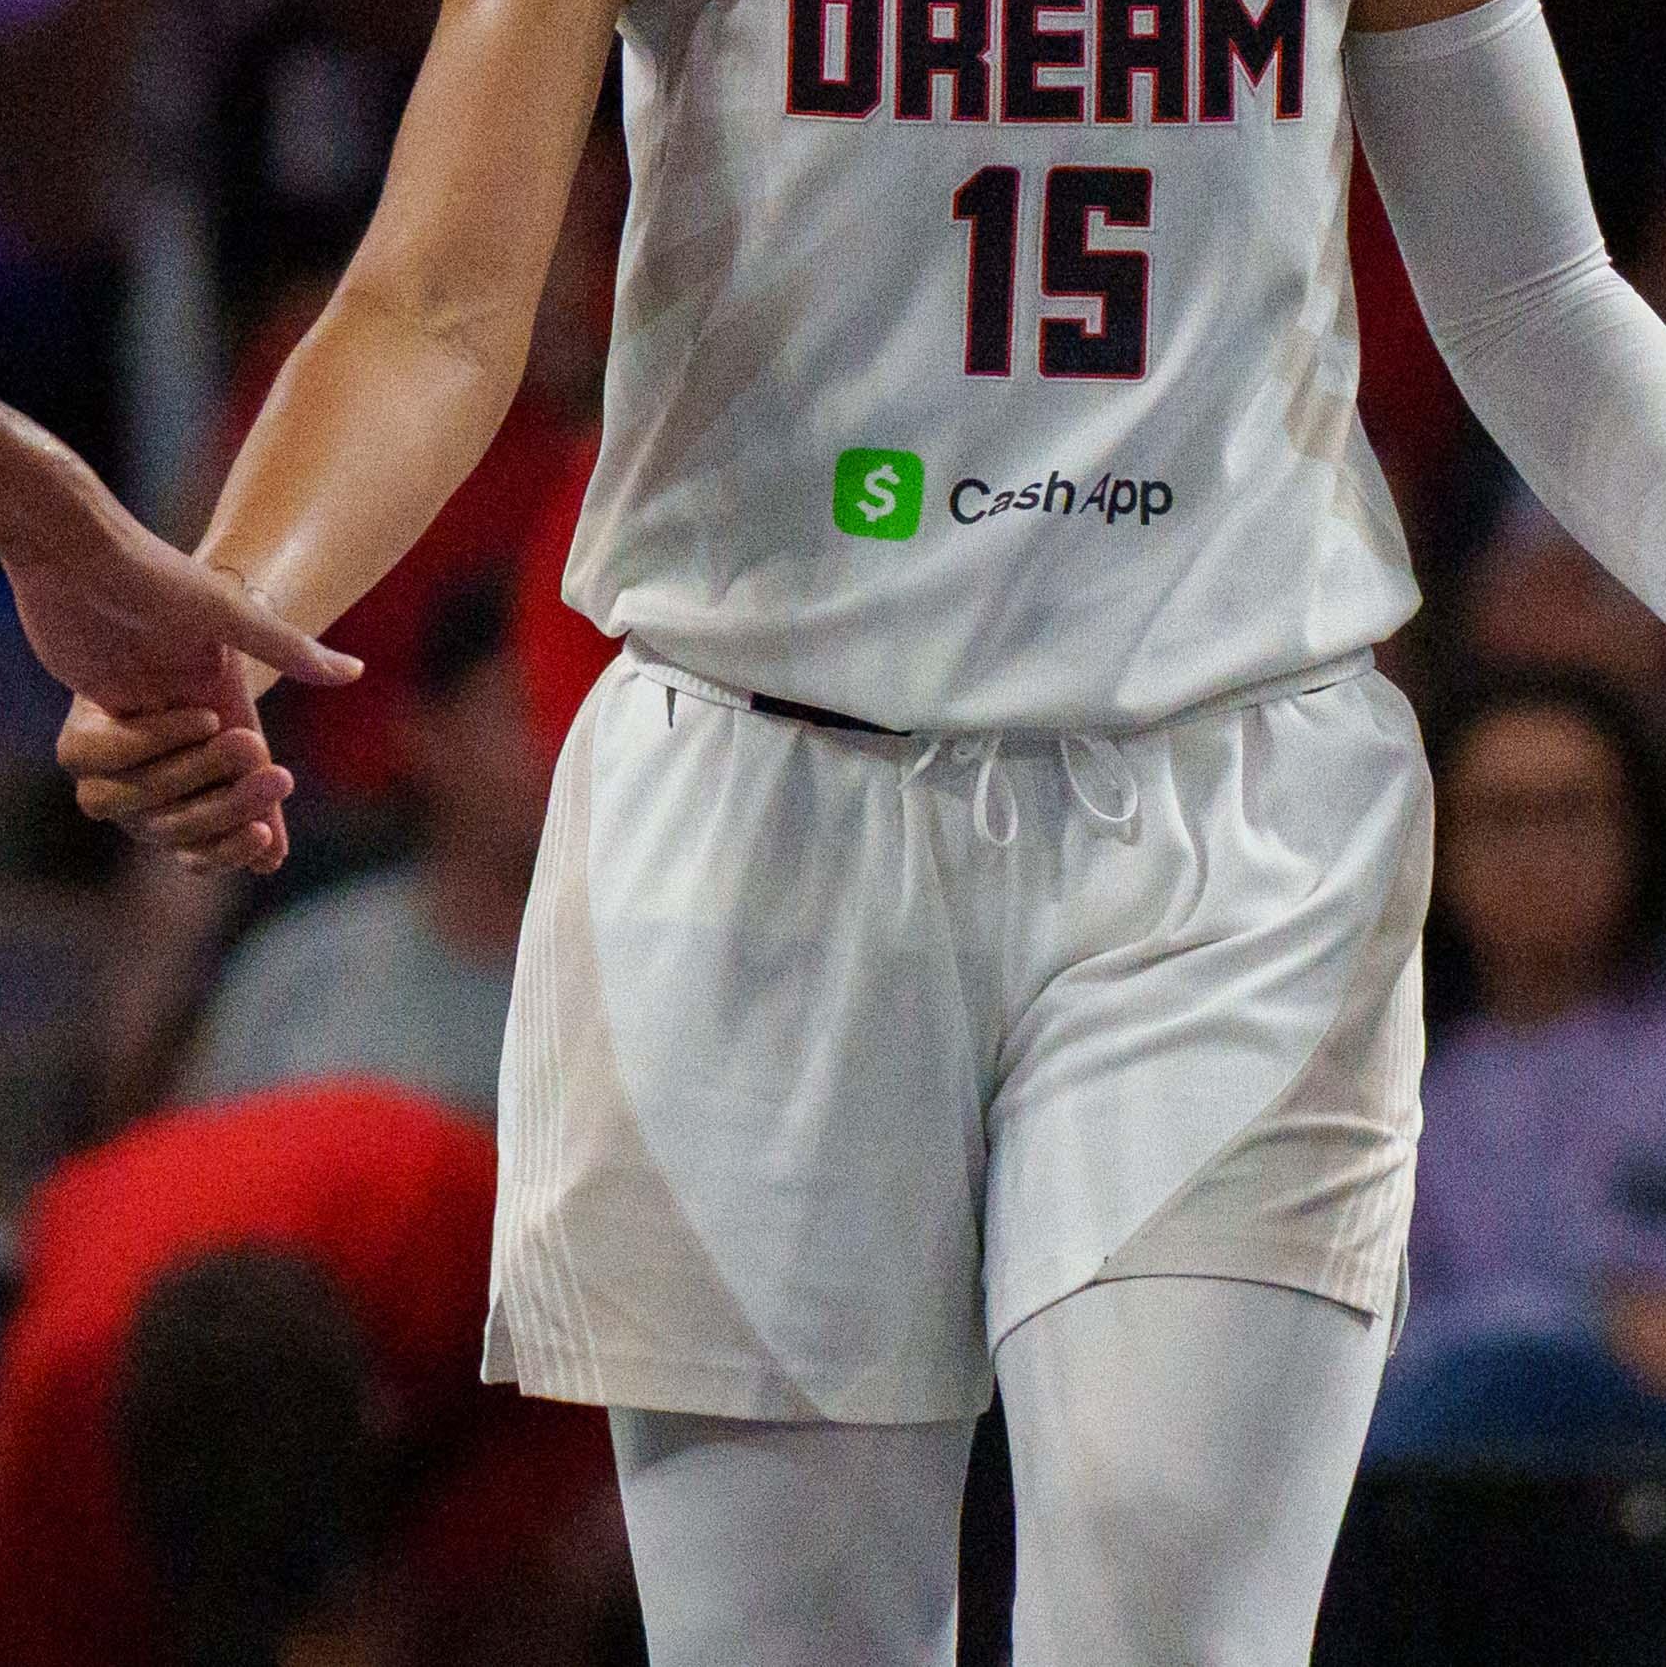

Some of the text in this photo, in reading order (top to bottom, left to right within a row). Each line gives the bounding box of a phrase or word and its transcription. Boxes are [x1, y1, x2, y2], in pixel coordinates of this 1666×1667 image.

[951, 164, 1154, 381] 15
[948, 470, 1077, 525] Cash
[1079, 472, 1174, 526] App
